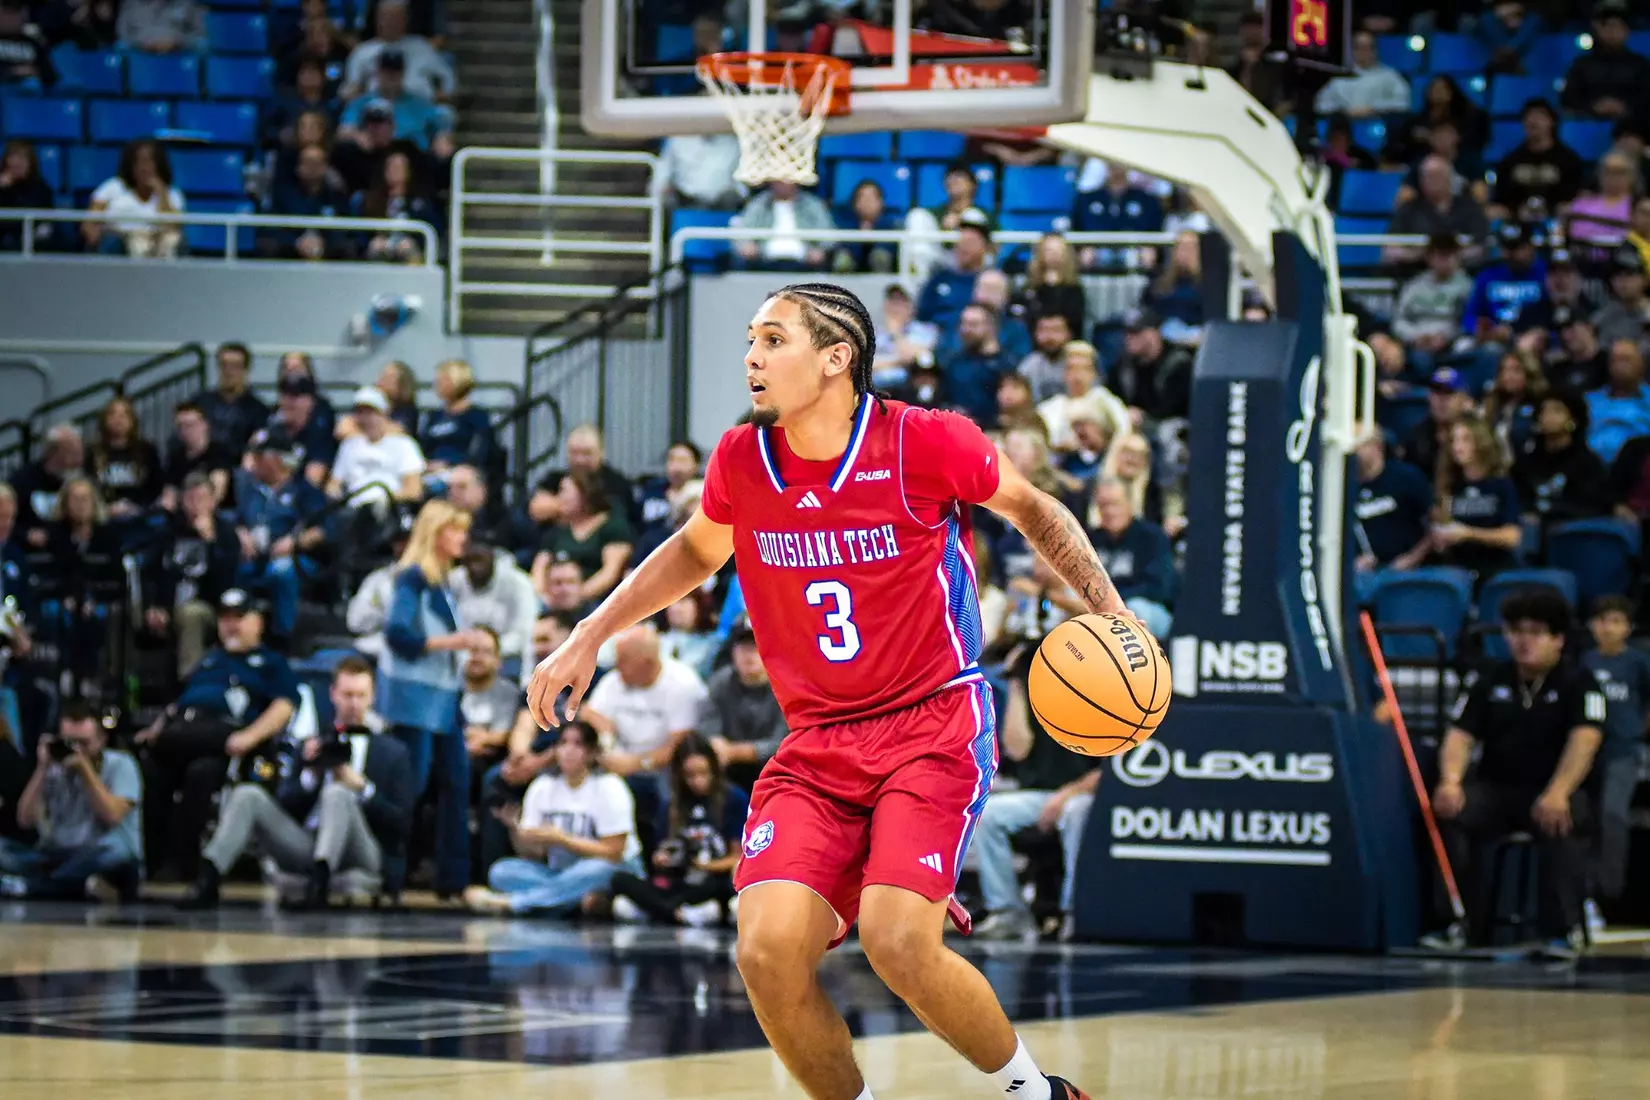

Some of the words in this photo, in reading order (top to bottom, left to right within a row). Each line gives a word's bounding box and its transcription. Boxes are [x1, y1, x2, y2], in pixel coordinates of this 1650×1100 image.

[1227, 382, 1247, 445] BANK
[1224, 449, 1245, 518] STATE
[753, 530, 844, 568] LOUISIANA
[843, 524, 900, 564] TECH
[1222, 521, 1243, 615] NEVADA
[804, 580, 861, 663] 3
[1096, 613, 1149, 672] Wilso
[1065, 640, 1085, 662] NEVADA
[1201, 640, 1287, 679] NSB
[1172, 749, 1334, 782] LEXUS
[1111, 805, 1225, 842] DOLAN
[1231, 809, 1332, 845] LEXUS
